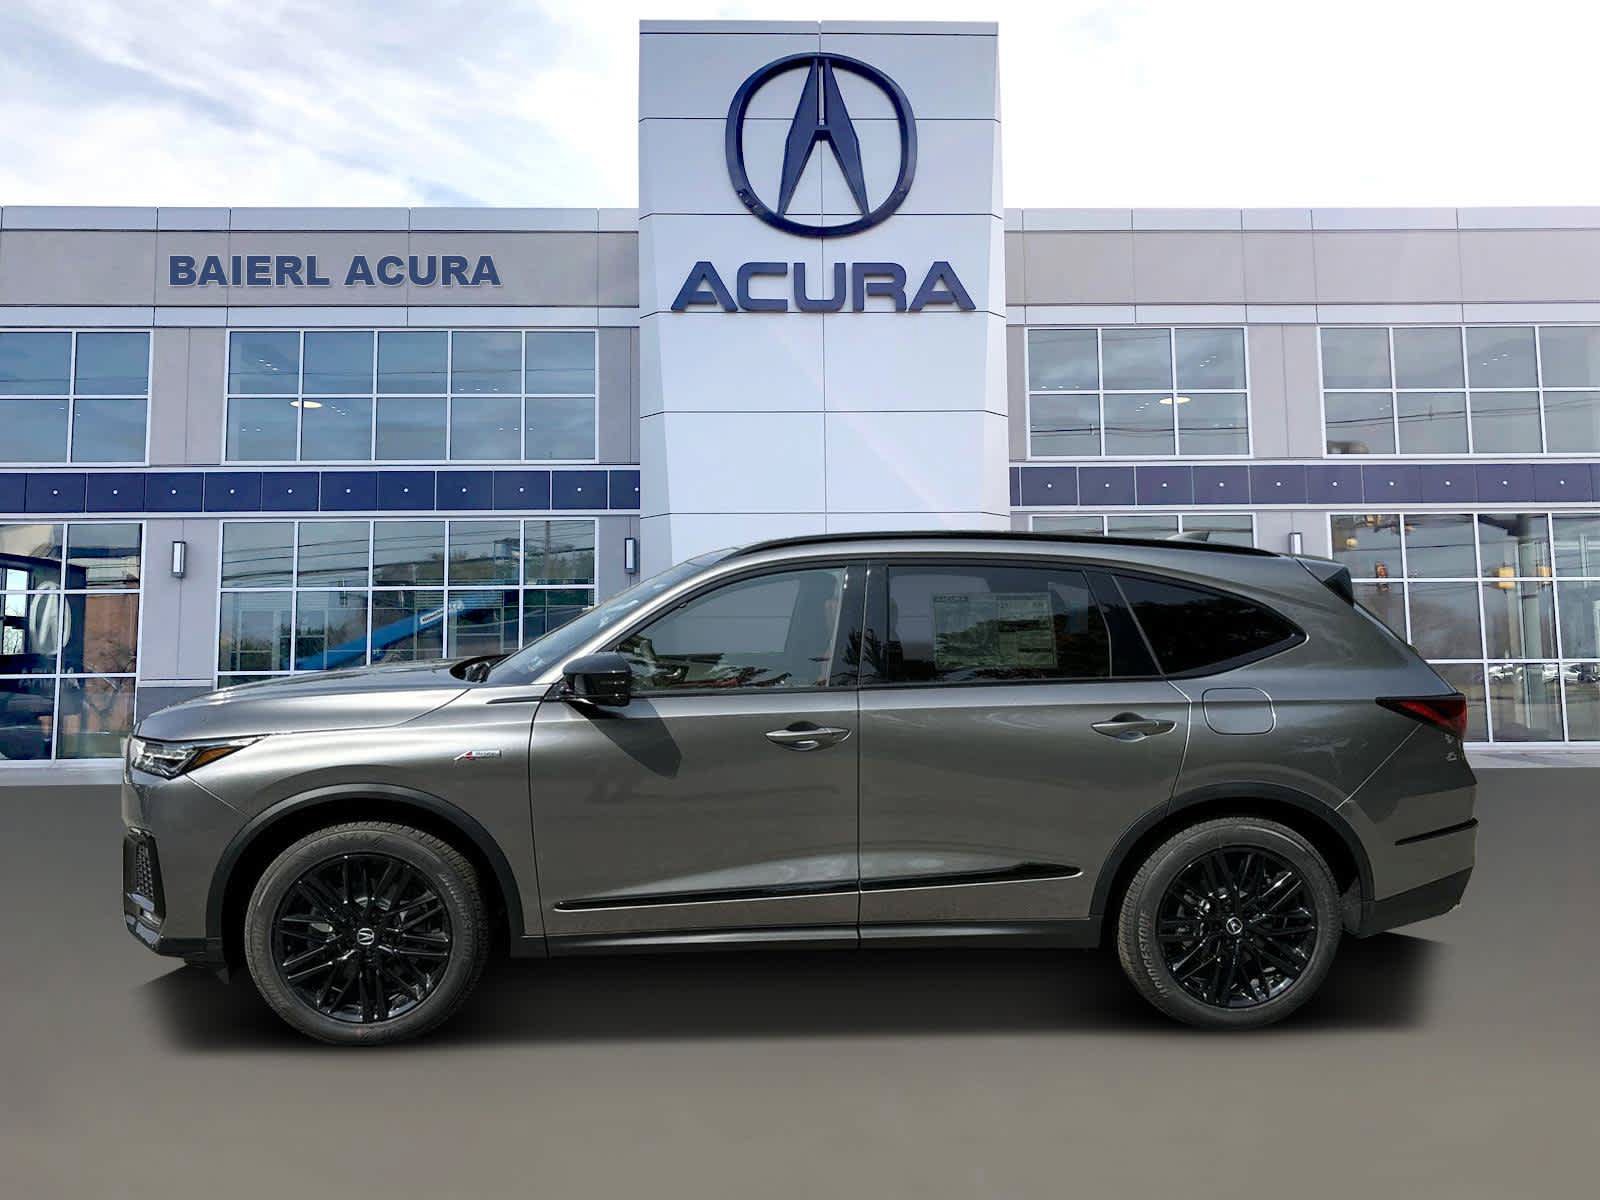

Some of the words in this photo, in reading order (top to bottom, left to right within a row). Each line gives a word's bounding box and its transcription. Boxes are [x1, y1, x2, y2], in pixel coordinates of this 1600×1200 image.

[169, 255, 330, 286] BAIERL
[344, 255, 502, 286] ACURA
[671, 261, 976, 313] ACURA
